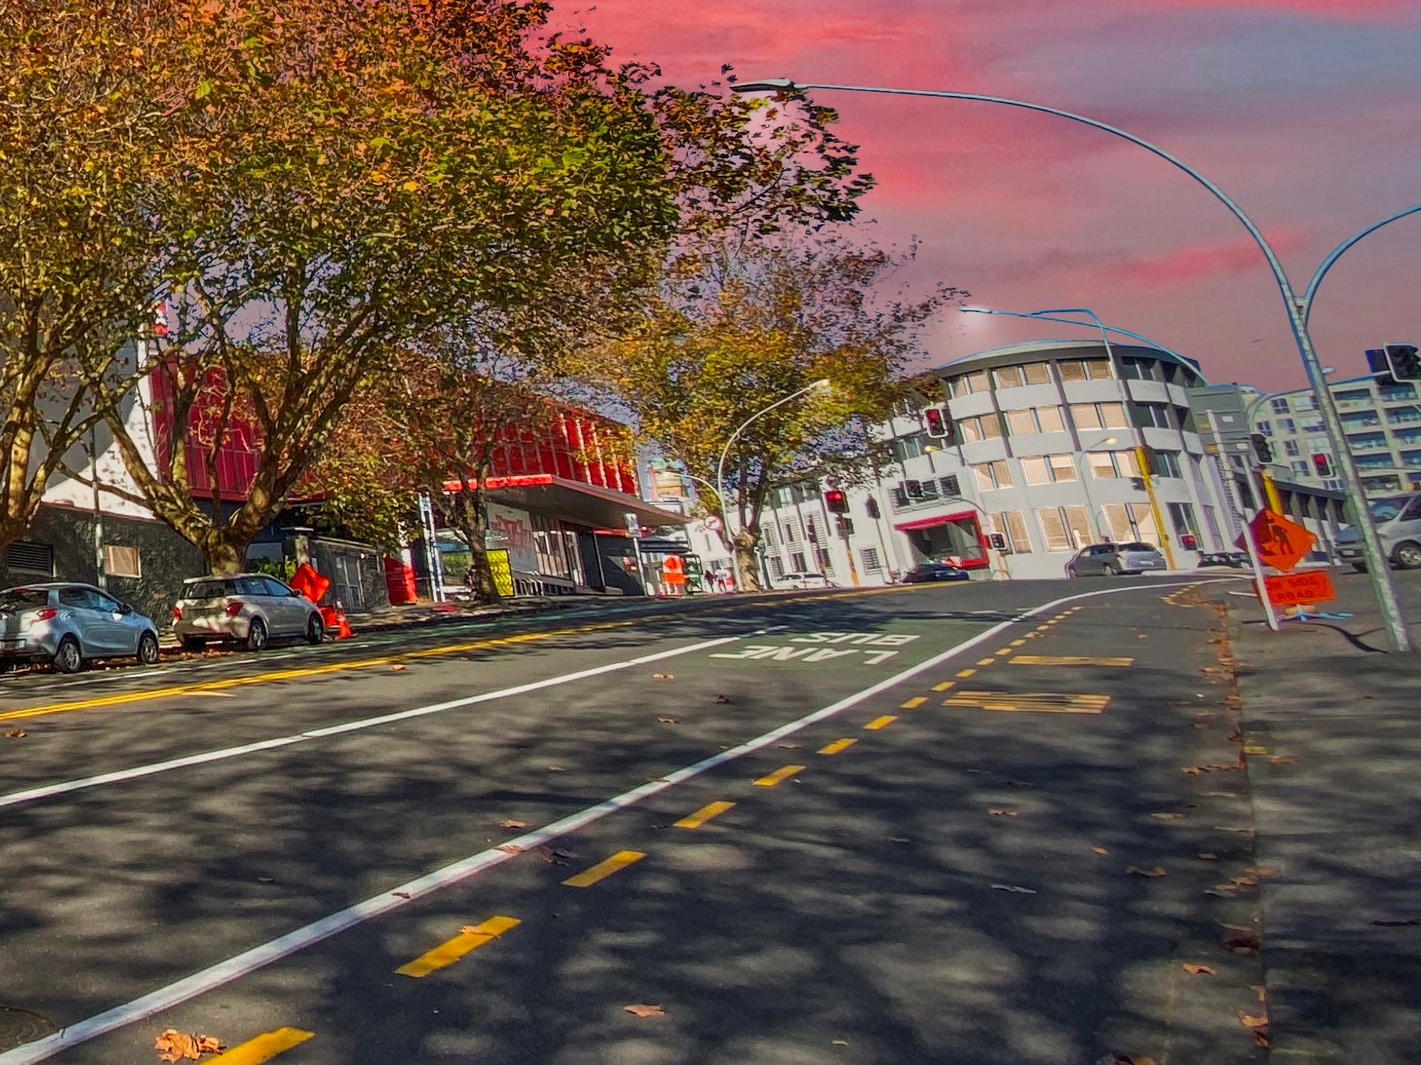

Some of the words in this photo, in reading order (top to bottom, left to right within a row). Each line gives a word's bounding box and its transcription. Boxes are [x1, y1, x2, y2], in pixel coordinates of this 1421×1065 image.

[1288, 576, 1319, 588] SIDE
[789, 632, 921, 646] BUS
[709, 645, 899, 665] LANE
